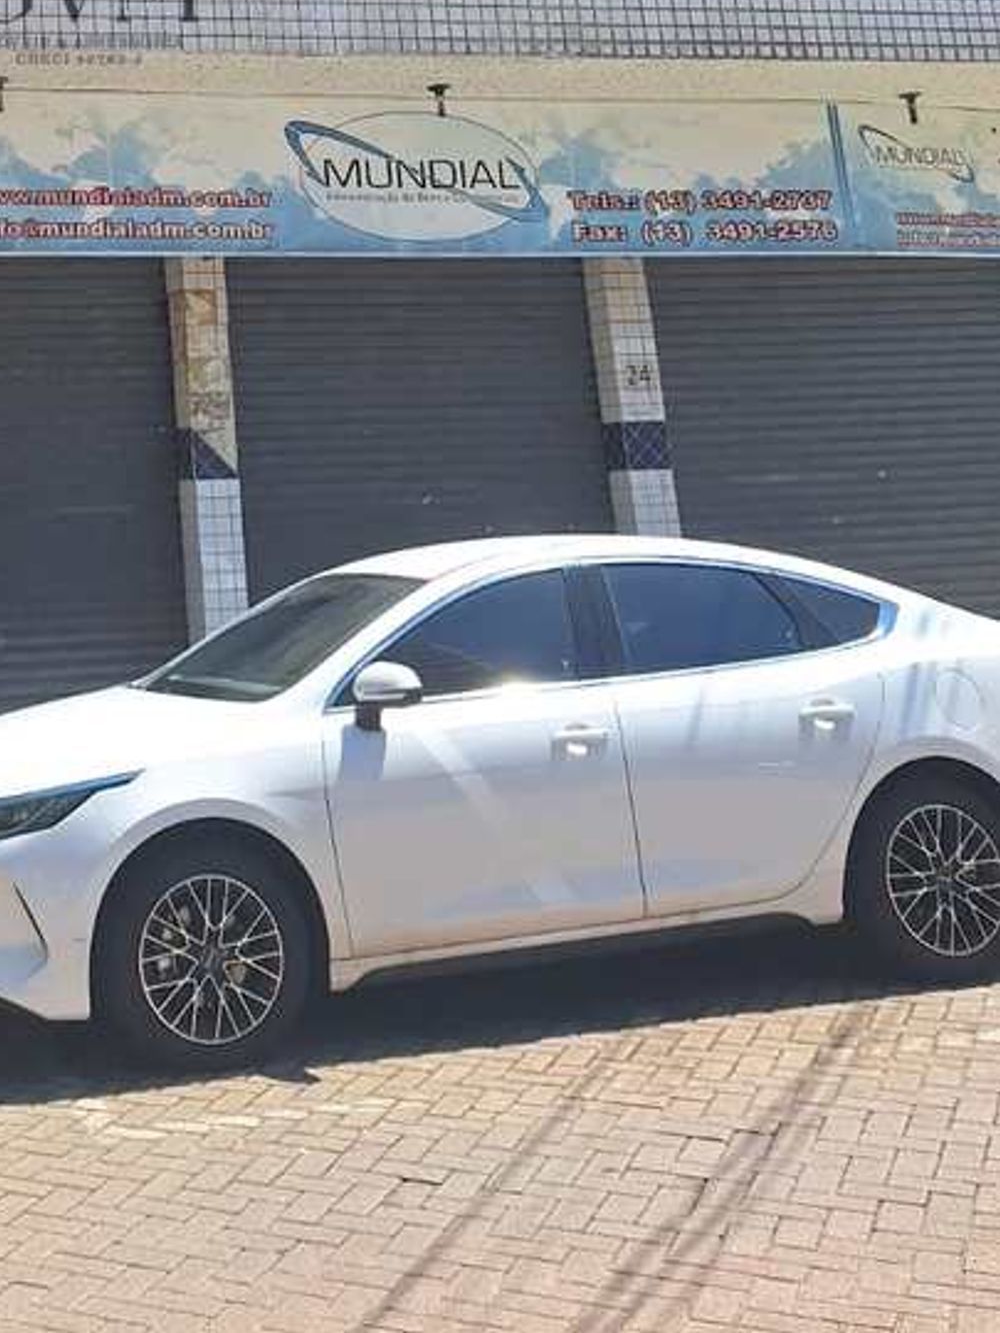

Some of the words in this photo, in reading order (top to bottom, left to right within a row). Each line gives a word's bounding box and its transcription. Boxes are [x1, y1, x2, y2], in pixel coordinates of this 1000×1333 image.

[874, 145, 967, 166] MUNDIAL
[322, 158, 521, 189] MUNDIAL
[641, 219, 692, 245] (13)
